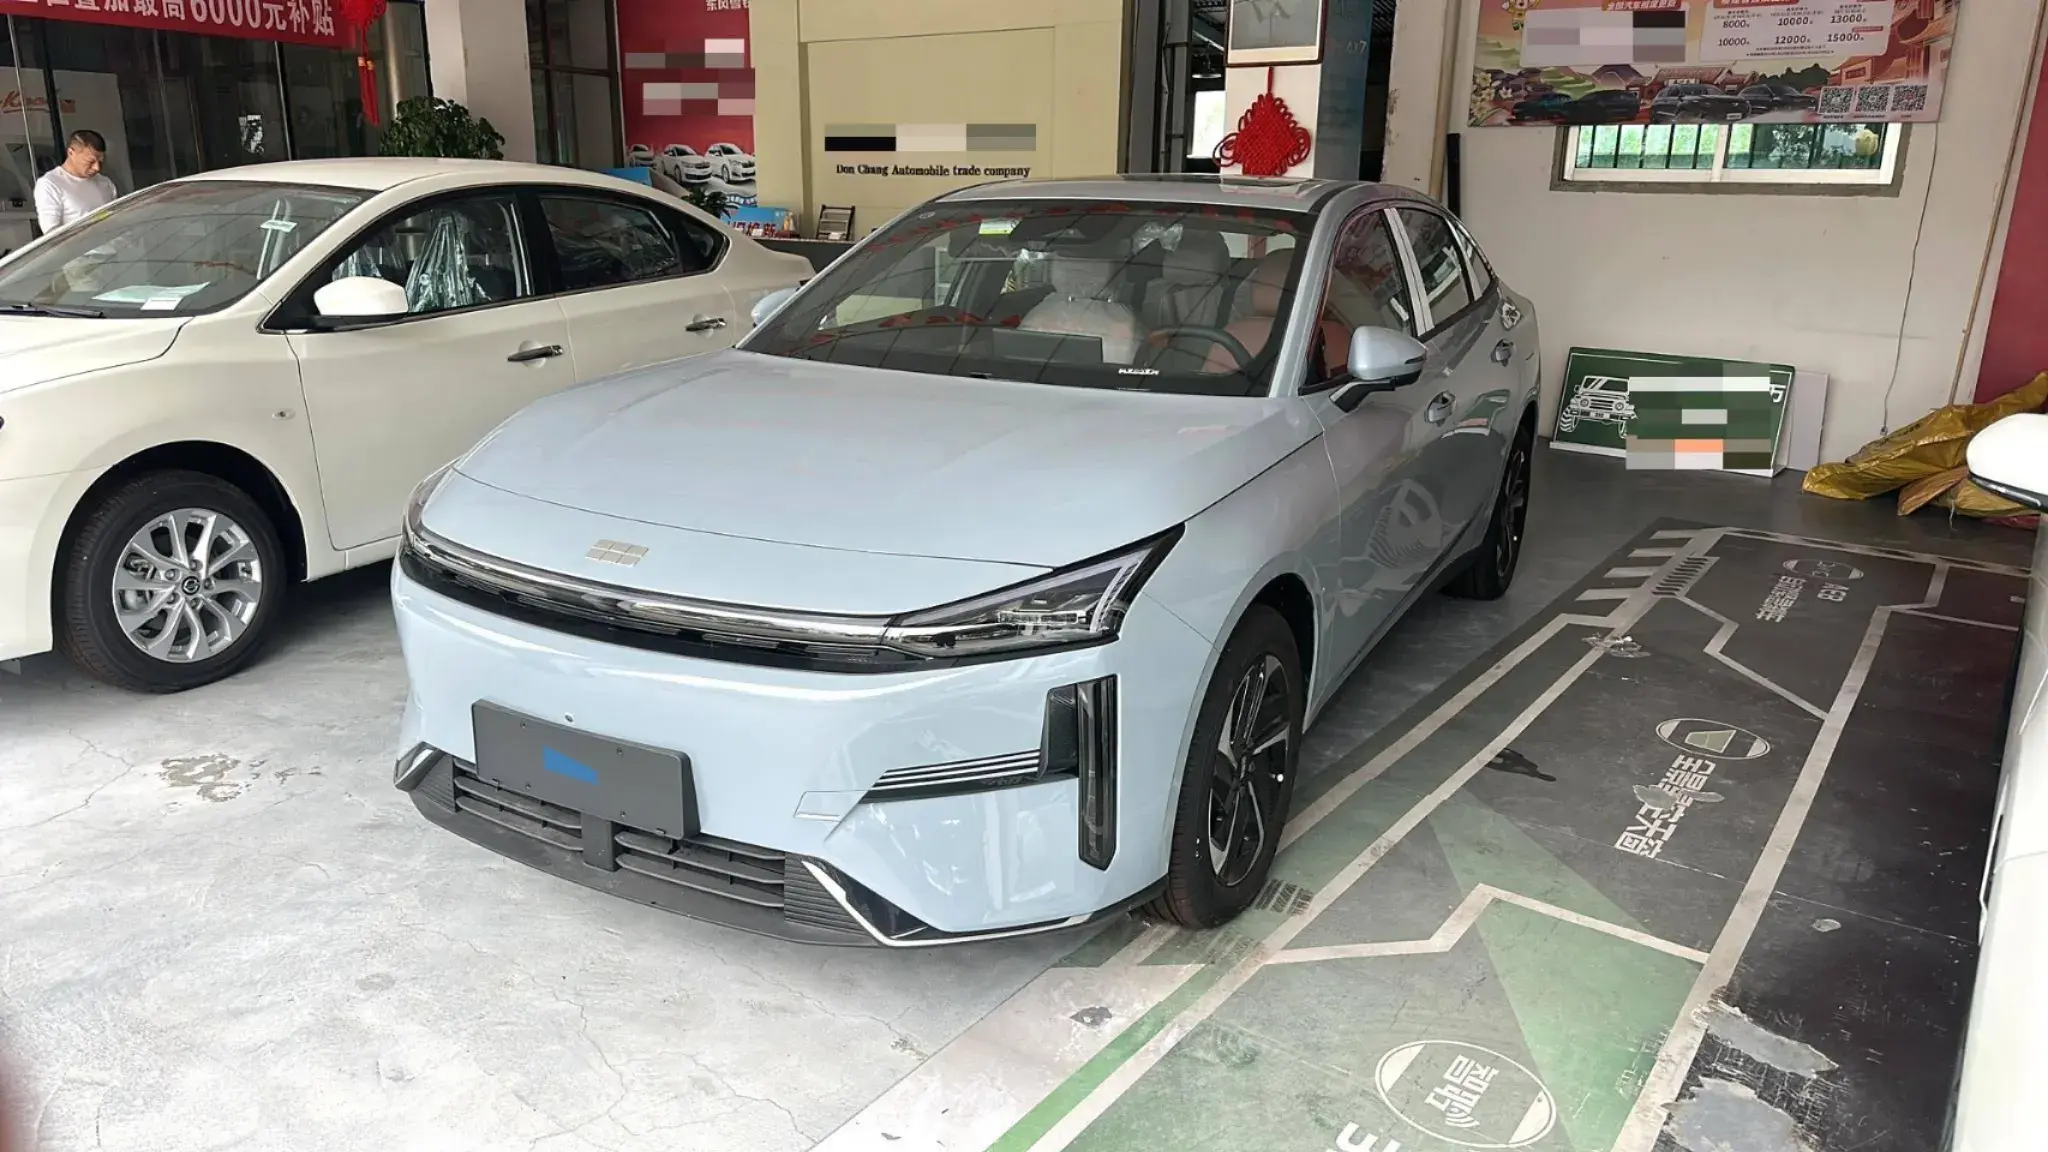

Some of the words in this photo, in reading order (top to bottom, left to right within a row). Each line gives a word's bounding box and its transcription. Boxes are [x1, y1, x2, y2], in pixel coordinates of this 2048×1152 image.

[836, 164, 855, 174] Don
[857, 164, 889, 177] Chang
[891, 165, 950, 176] Automobile
[952, 165, 981, 176] trade
[983, 167, 1031, 178] company
